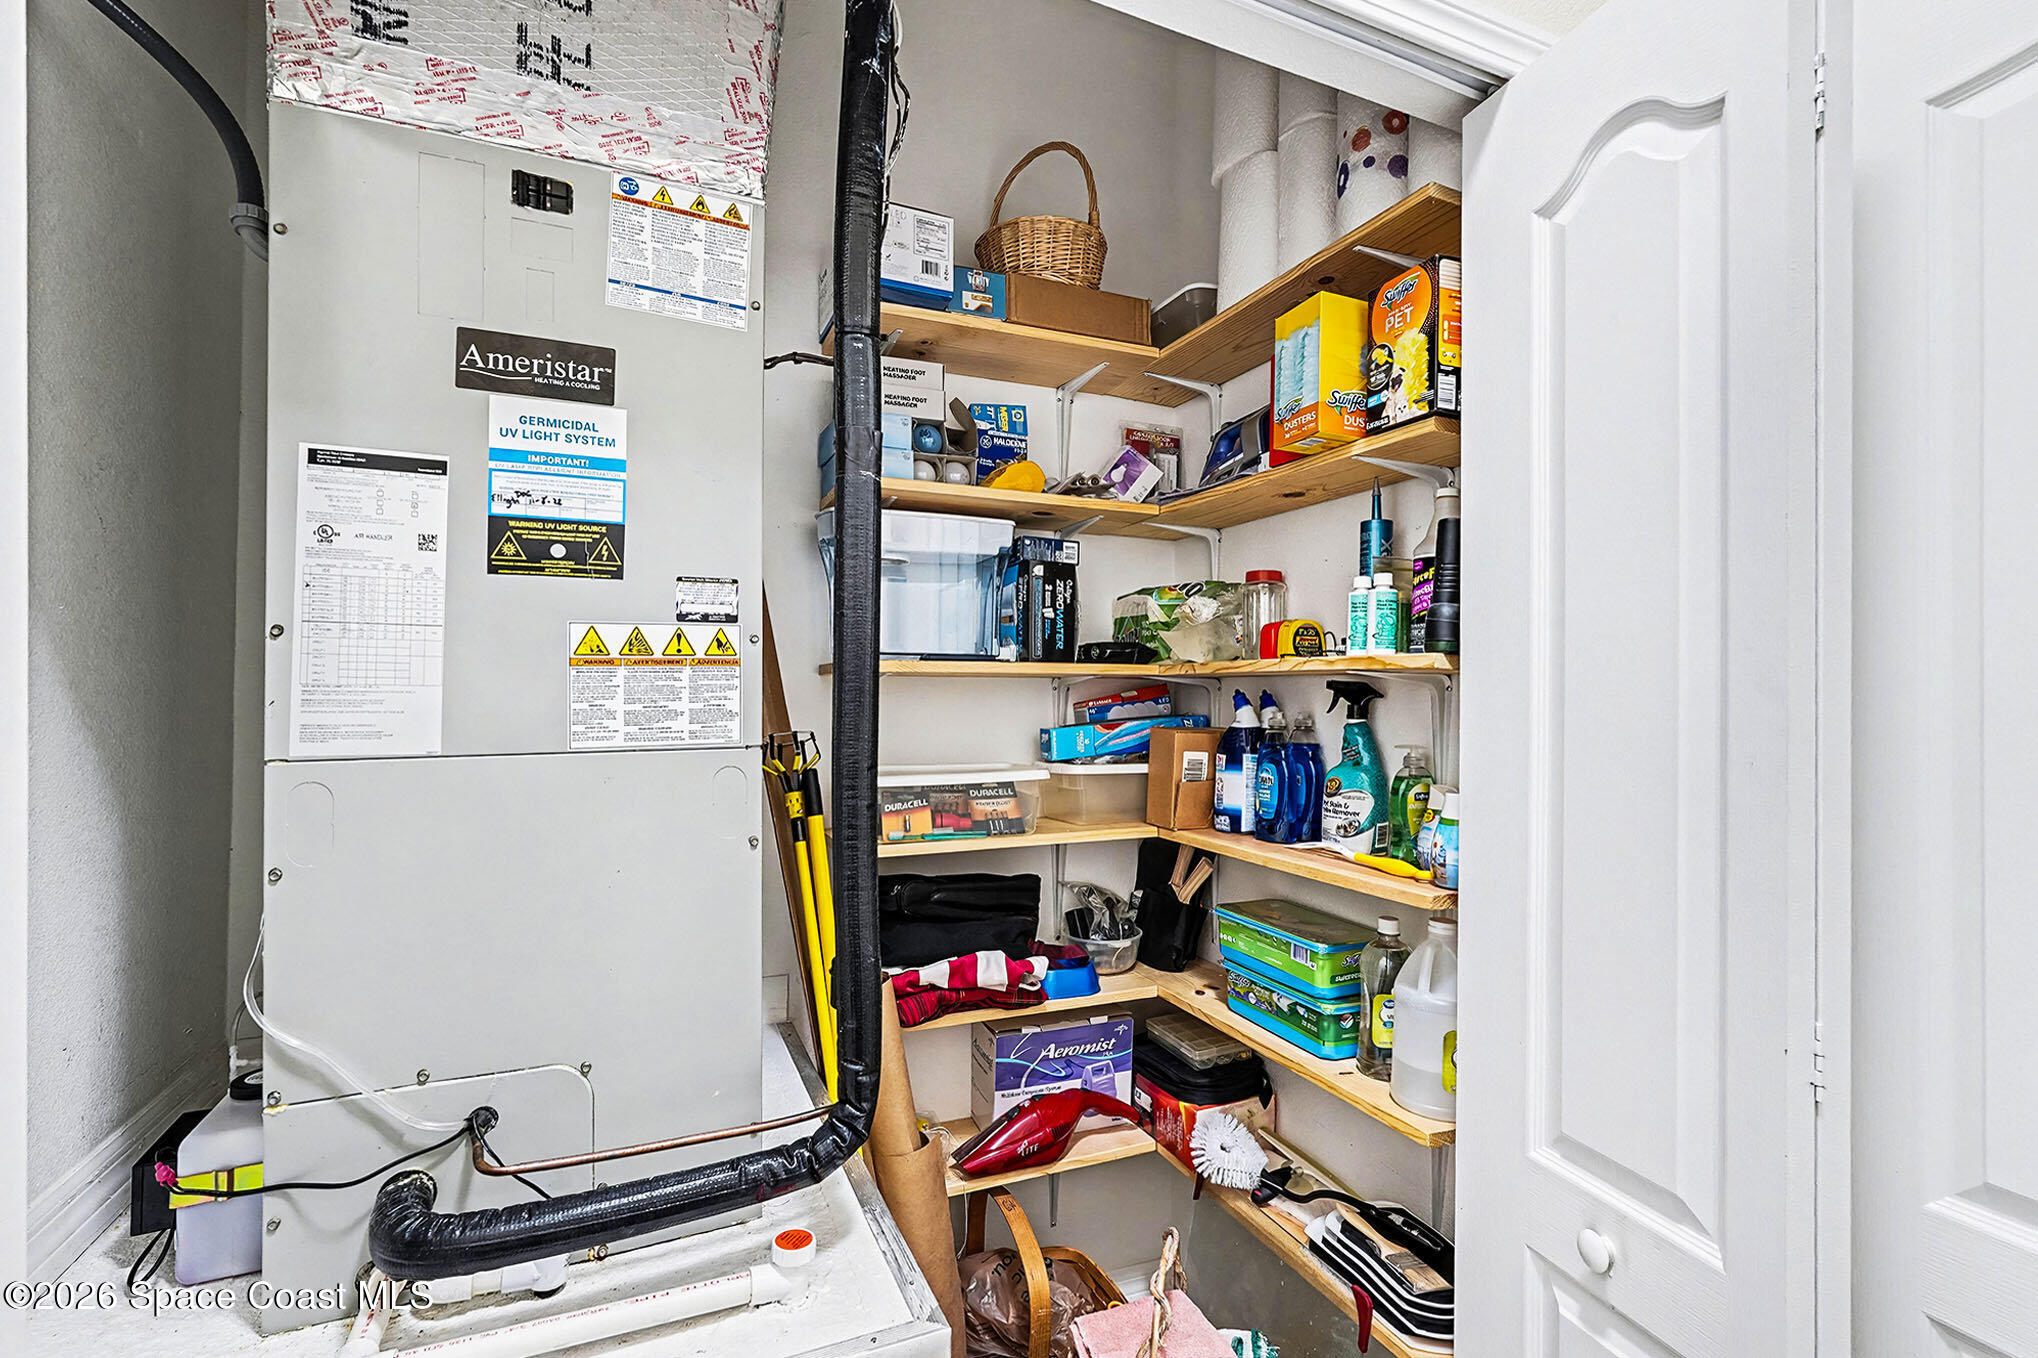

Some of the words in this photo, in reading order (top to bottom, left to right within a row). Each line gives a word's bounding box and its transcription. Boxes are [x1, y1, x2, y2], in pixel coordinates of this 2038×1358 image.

[1385, 307, 1414, 333] PET
[460, 343, 603, 383] Ameristar
[883, 365, 909, 374] HEATING
[910, 368, 926, 376] FOOT
[883, 372, 916, 381] MASSAGER
[534, 377, 565, 387] HEATING
[571, 382, 601, 391] COOLING
[884, 393, 911, 402] HEATING
[911, 396, 927, 404] FOOT
[884, 399, 918, 408] MASSAGER
[1327, 389, 1367, 413] Swiffe
[518, 414, 599, 433] GERMICIDAL
[1284, 411, 1316, 431] DUSTERS
[1344, 415, 1366, 427] DUS
[499, 427, 518, 438] UV
[522, 430, 560, 442] LIGHT
[564, 433, 616, 448] SYSTEM
[527, 454, 590, 468] IMPORTANT!
[508, 520, 544, 530] WARNING
[556, 523, 578, 531] LIGHT
[578, 524, 607, 533] SOURCE
[1055, 579, 1064, 650] ZEROWATER
[584, 658, 614, 666] WARNING
[696, 658, 738, 666] ADVERTENCIA
[970, 788, 1013, 797] DURACELL
[885, 799, 928, 812] DURACELL
[1332, 809, 1360, 817] Remover
[1040, 1038, 1116, 1059] Aeromist
